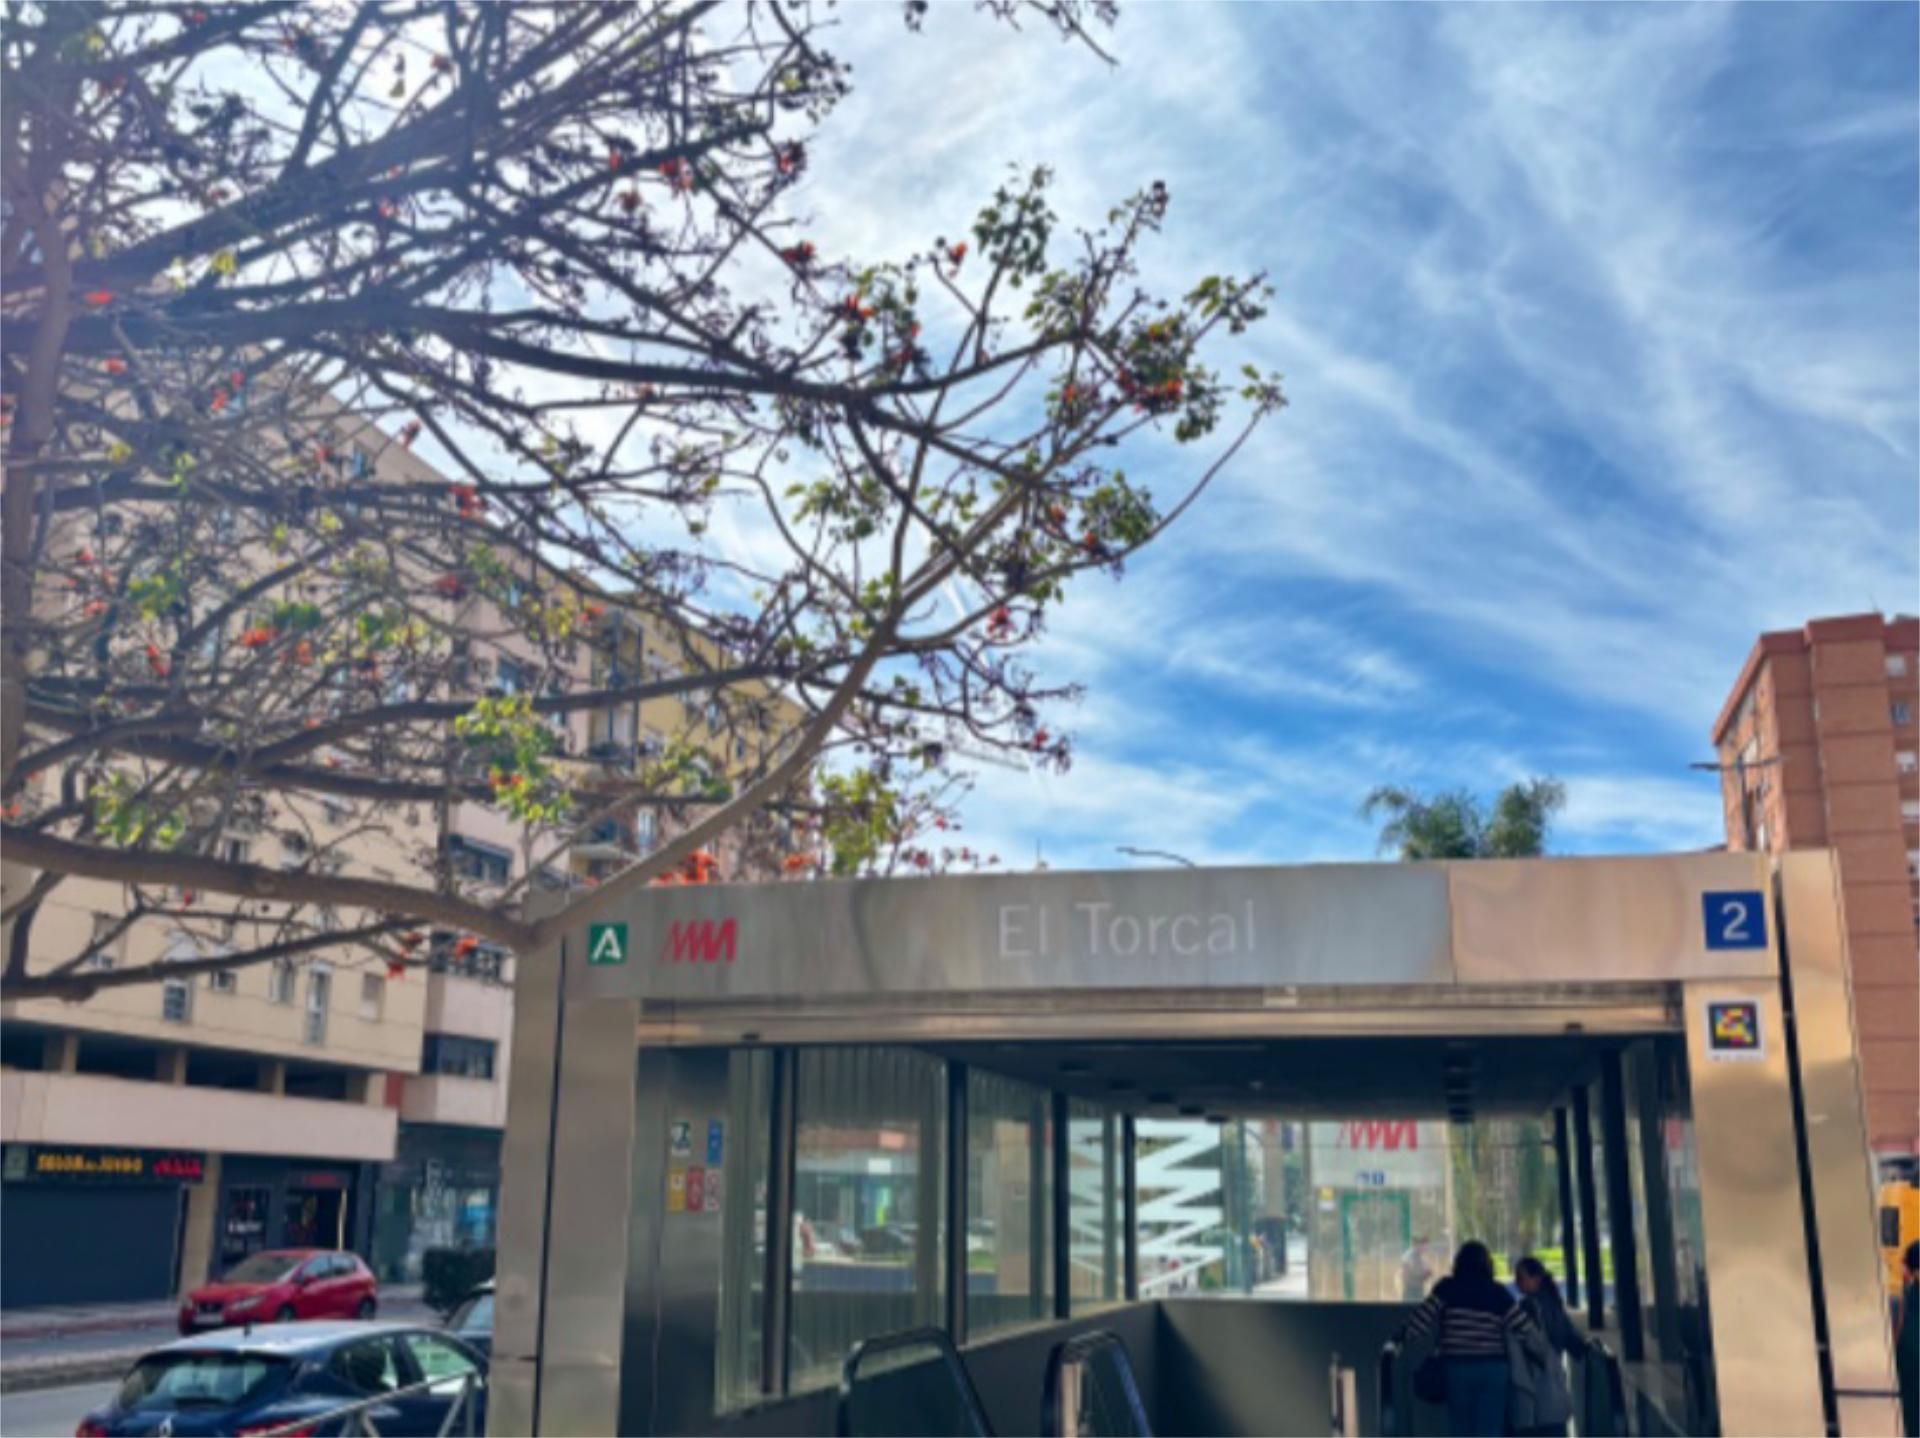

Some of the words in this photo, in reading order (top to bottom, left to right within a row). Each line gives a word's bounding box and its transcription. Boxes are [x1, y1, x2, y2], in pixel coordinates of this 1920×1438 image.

[999, 904, 1048, 959] El
[1074, 899, 1257, 957] Torcal
[1721, 901, 1750, 941] 2
